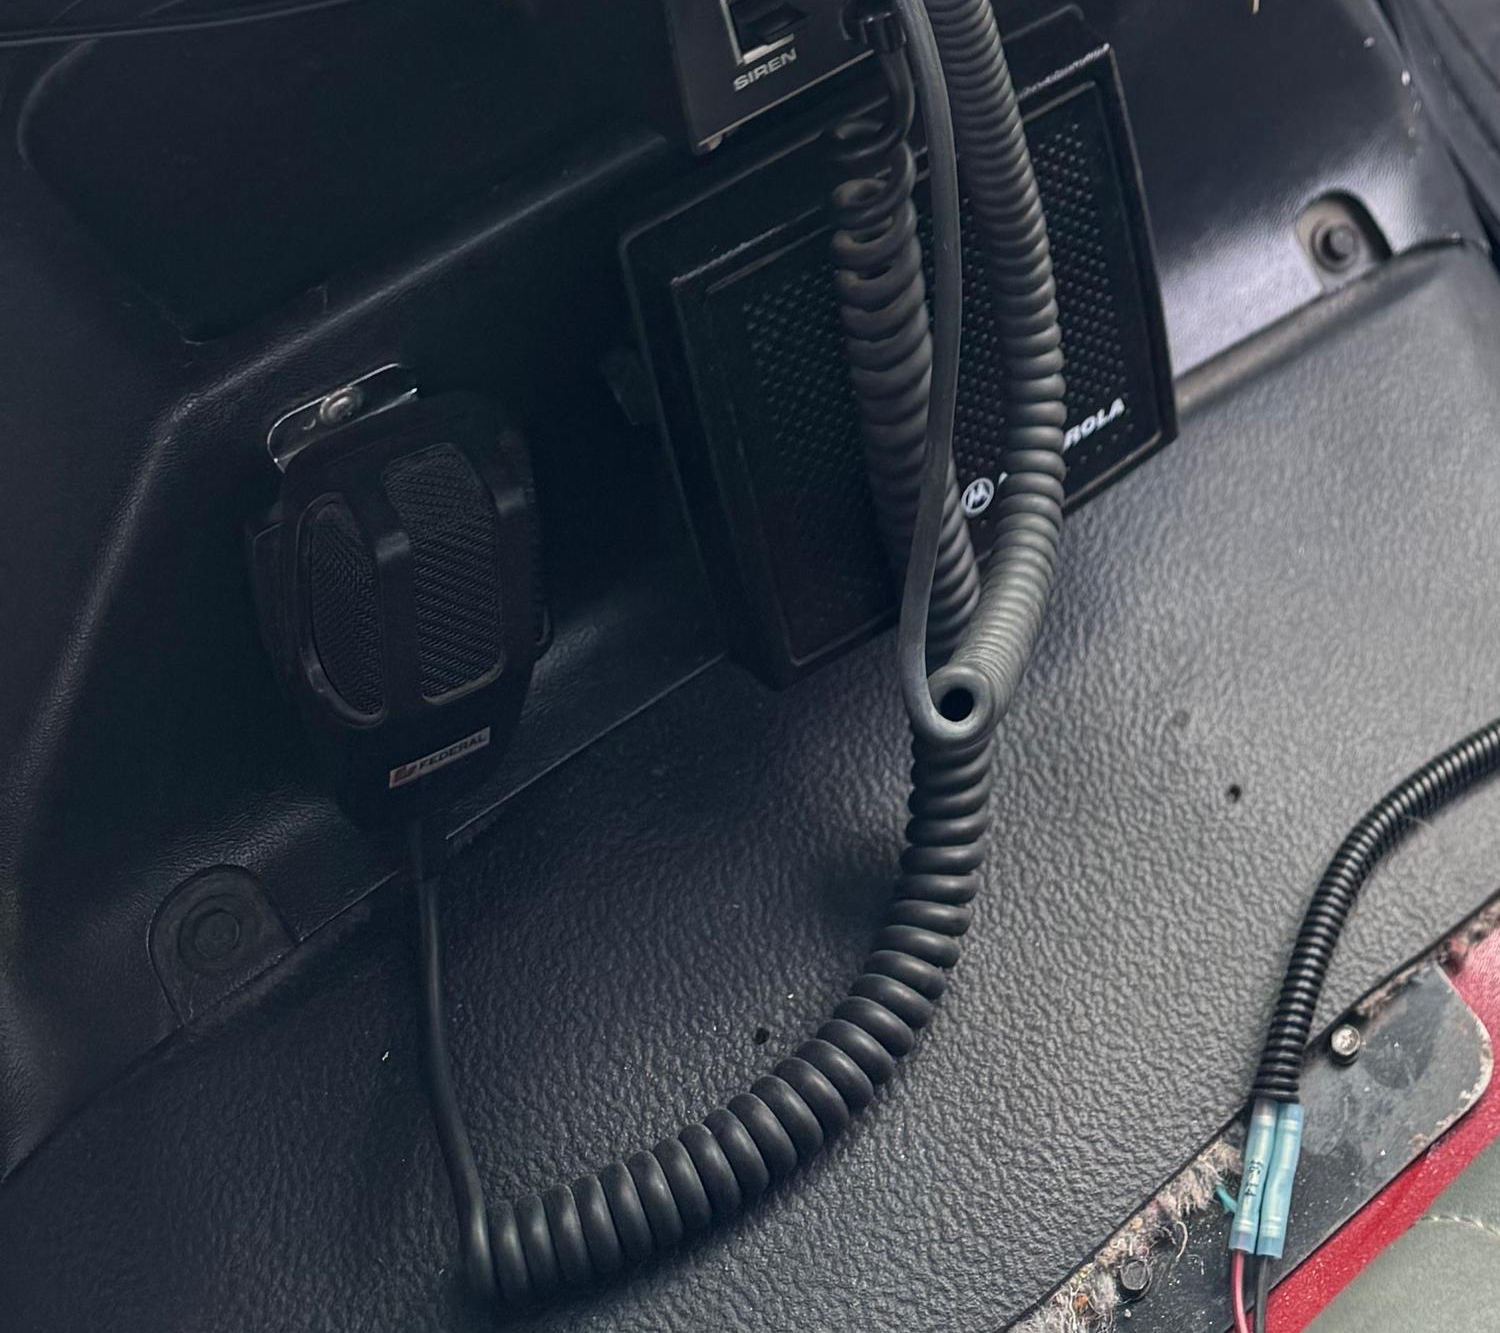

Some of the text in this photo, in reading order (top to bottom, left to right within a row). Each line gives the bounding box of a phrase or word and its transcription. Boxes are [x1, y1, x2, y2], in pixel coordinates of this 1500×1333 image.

[733, 48, 797, 92] SIREN
[1062, 397, 1125, 453] ROLA
[419, 734, 487, 770] FEDERAL
